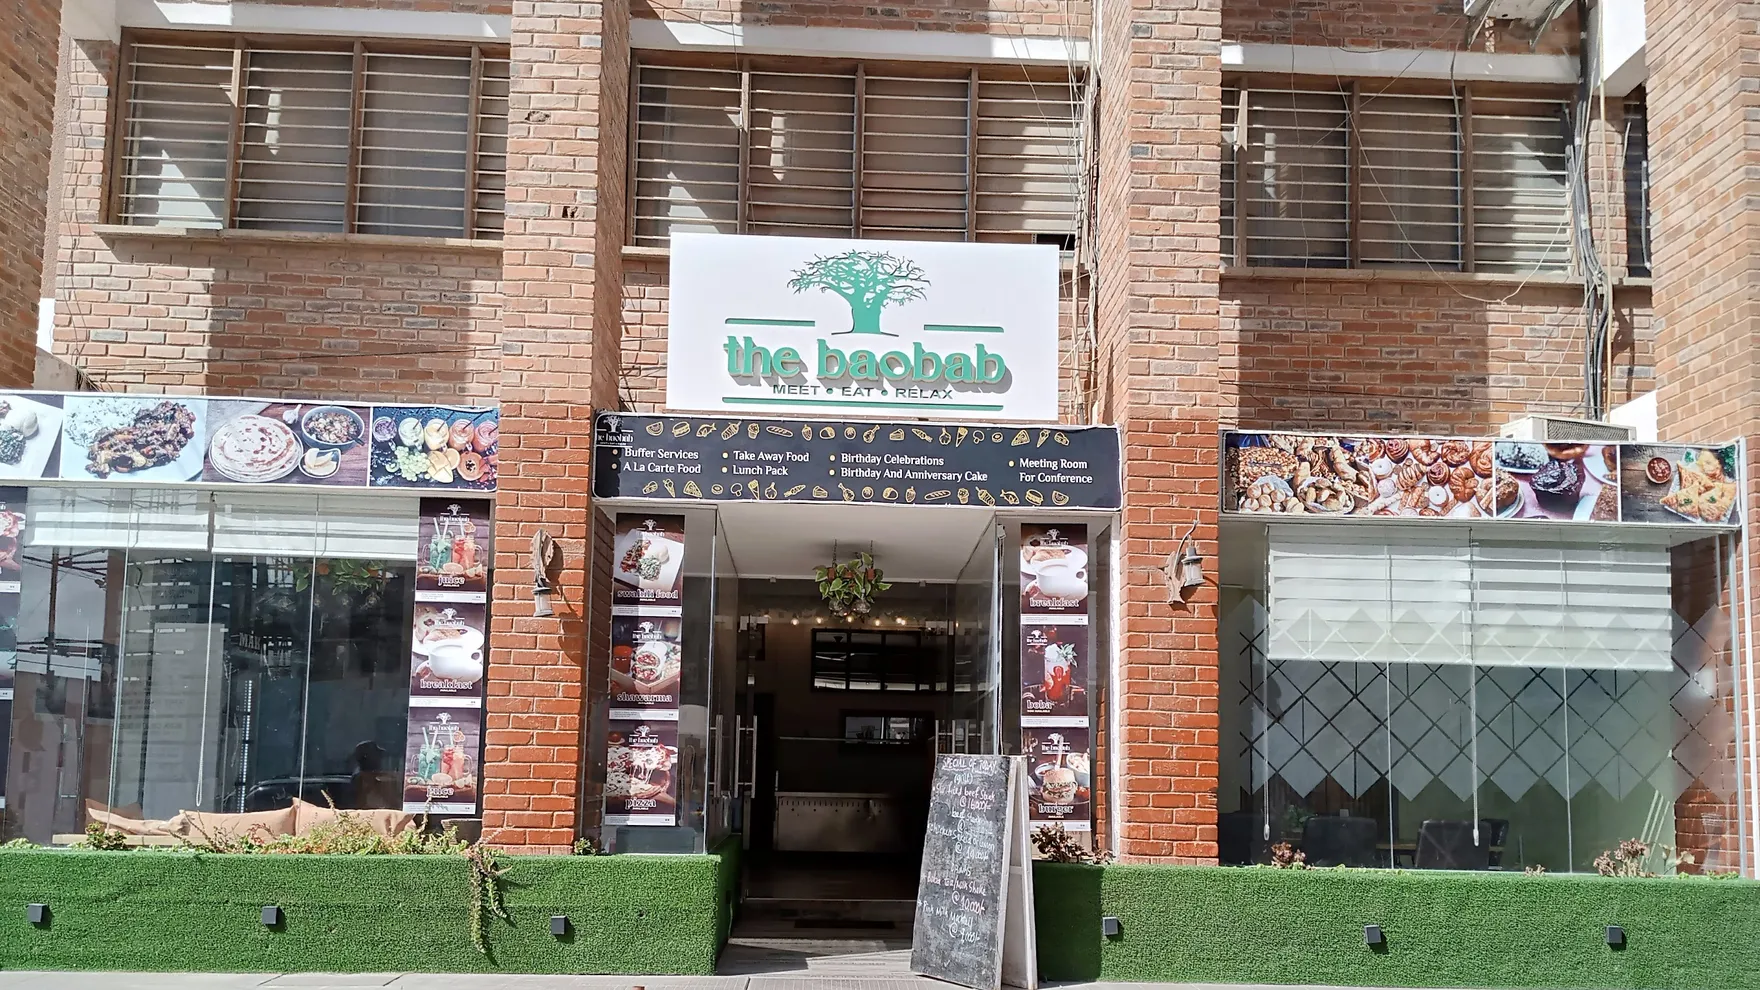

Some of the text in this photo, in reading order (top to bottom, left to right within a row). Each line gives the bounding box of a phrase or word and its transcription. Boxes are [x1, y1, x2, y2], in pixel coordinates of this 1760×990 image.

[723, 335, 1007, 384] the baobab
[773, 384, 954, 400] MEET EAT RELAX
[624, 448, 699, 460] Buffer Services
[733, 451, 810, 463] Take Away Food
[841, 453, 944, 466] Birthday Celebrations
[623, 462, 701, 474] A La Carte Food
[733, 465, 788, 476] Lunch Pack
[1019, 458, 1088, 471] Meeting Room
[841, 467, 988, 483] Birthday And Anniversary Cake
[1019, 472, 1093, 484] For Conference
[438, 574, 465, 586] juice
[655, 589, 679, 599] food
[1029, 597, 1080, 607] breakfast
[420, 679, 473, 689] breakfast
[616, 692, 672, 702] shawarma
[1027, 699, 1053, 710] boba
[625, 798, 657, 810] pizza
[1038, 803, 1074, 815] burger
